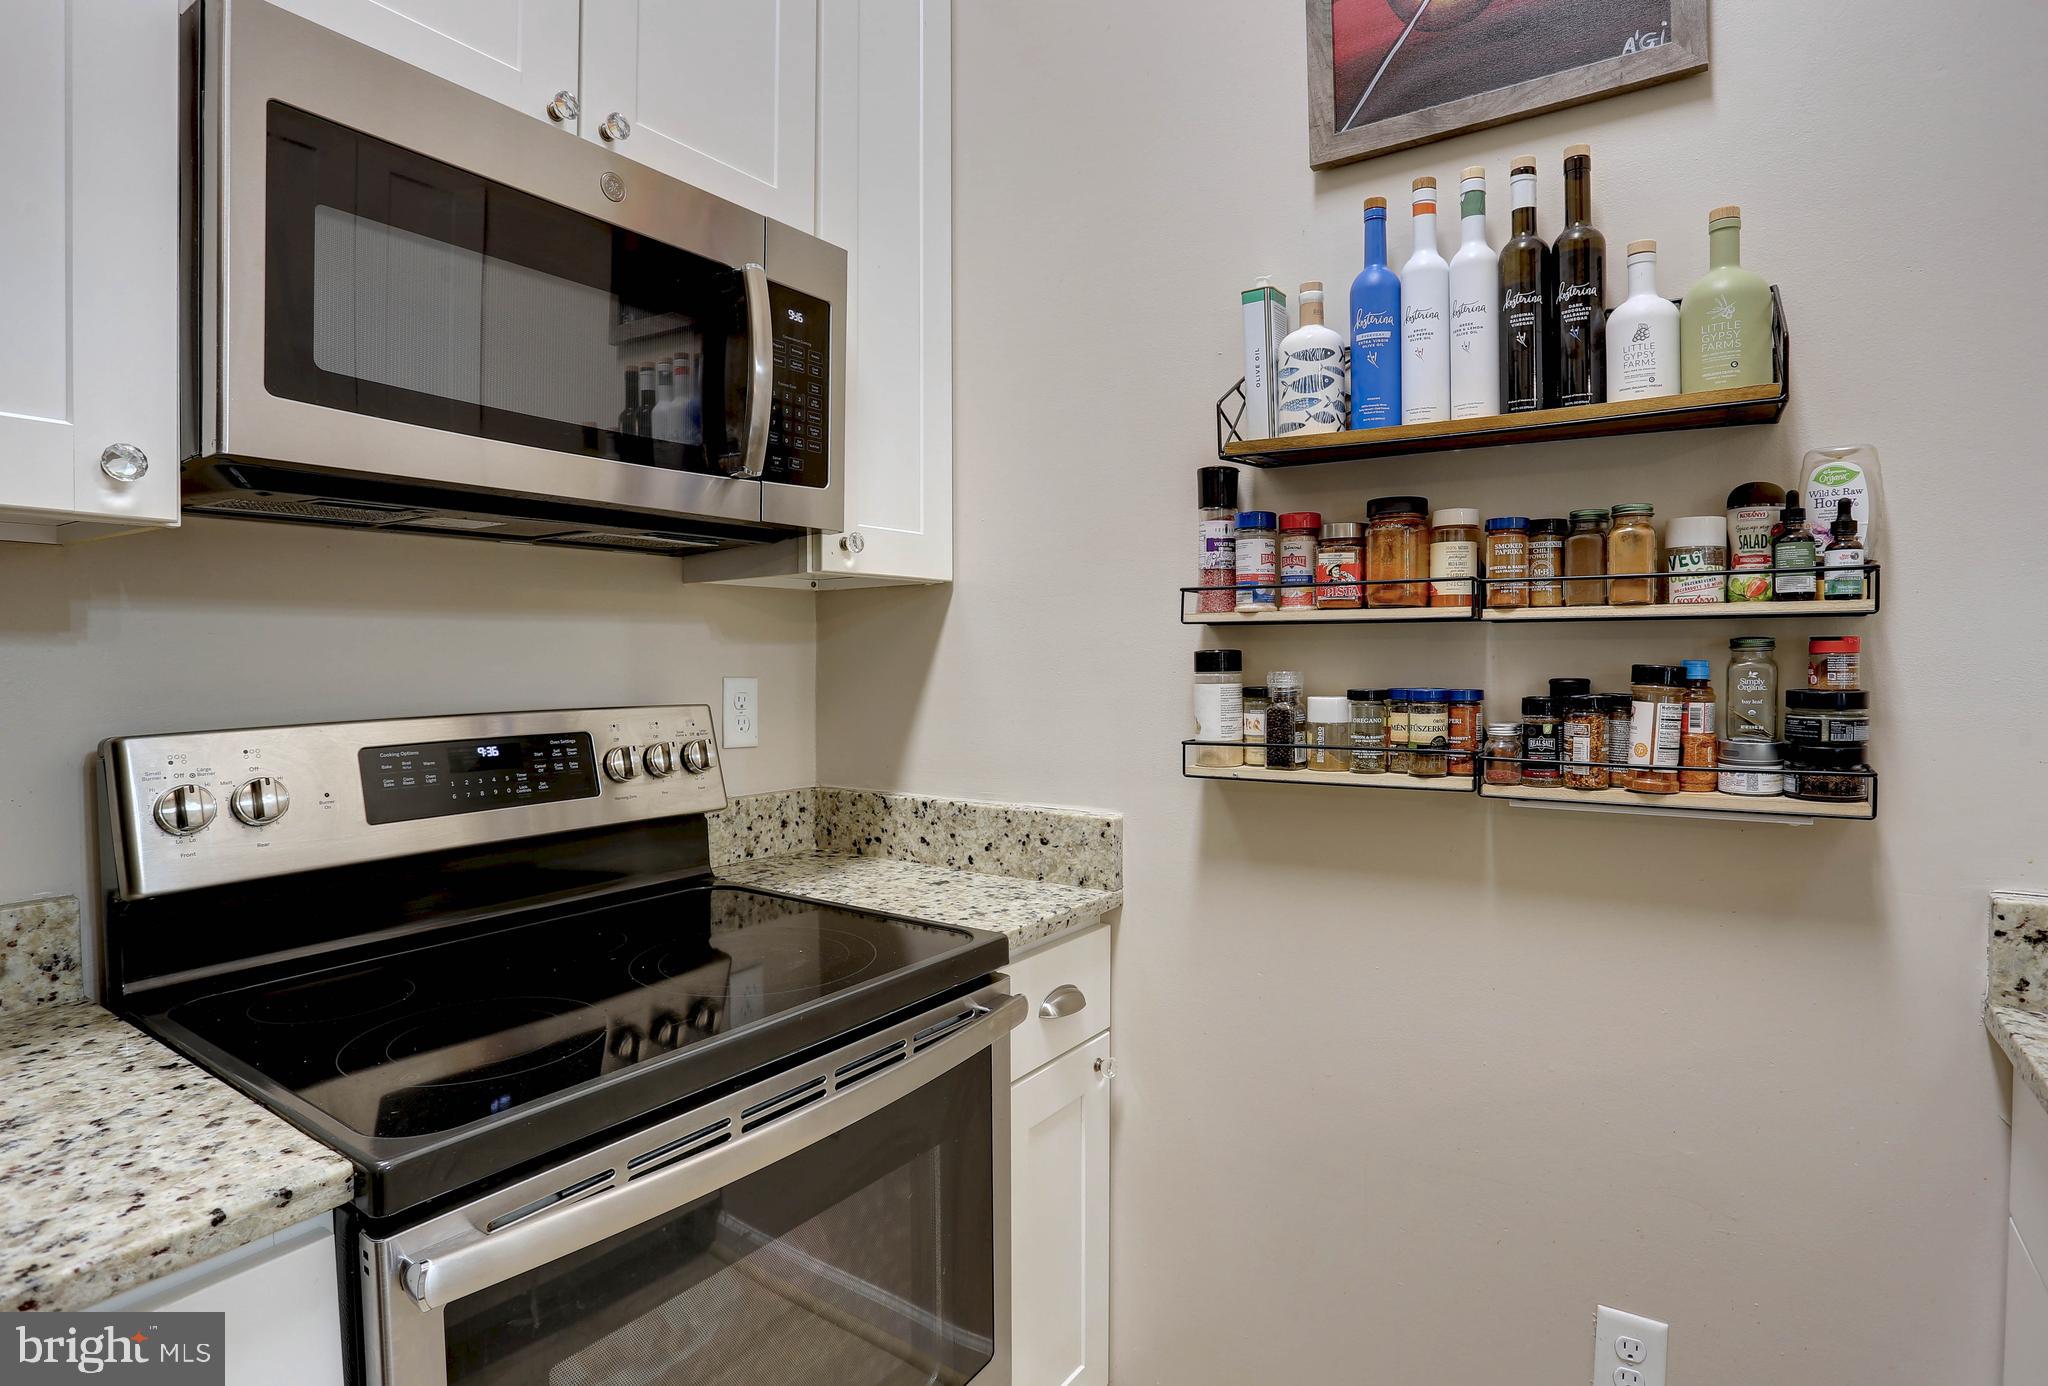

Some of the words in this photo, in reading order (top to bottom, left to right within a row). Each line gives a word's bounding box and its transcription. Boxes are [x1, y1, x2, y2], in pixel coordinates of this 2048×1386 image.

[1701, 319, 1742, 335] LITTLE
[1702, 331, 1742, 344] GYPSY
[1623, 342, 1656, 354] LITTLE
[1702, 339, 1742, 353] FARMS
[1624, 350, 1656, 361] GYPSY
[1624, 359, 1657, 370] FARMS
[1809, 490, 1830, 498] Wild
[1831, 488, 1842, 496] &
[1843, 487, 1864, 495] Raw
[1814, 497, 1857, 509] Hony
[1739, 533, 1768, 551] SALAD
[1494, 548, 1524, 556] PAPRIKA
[1739, 677, 1766, 686] Simply
[1737, 683, 1768, 692] Organic
[477, 746, 500, 757] 9:36
[180, 852, 197, 860] Front
